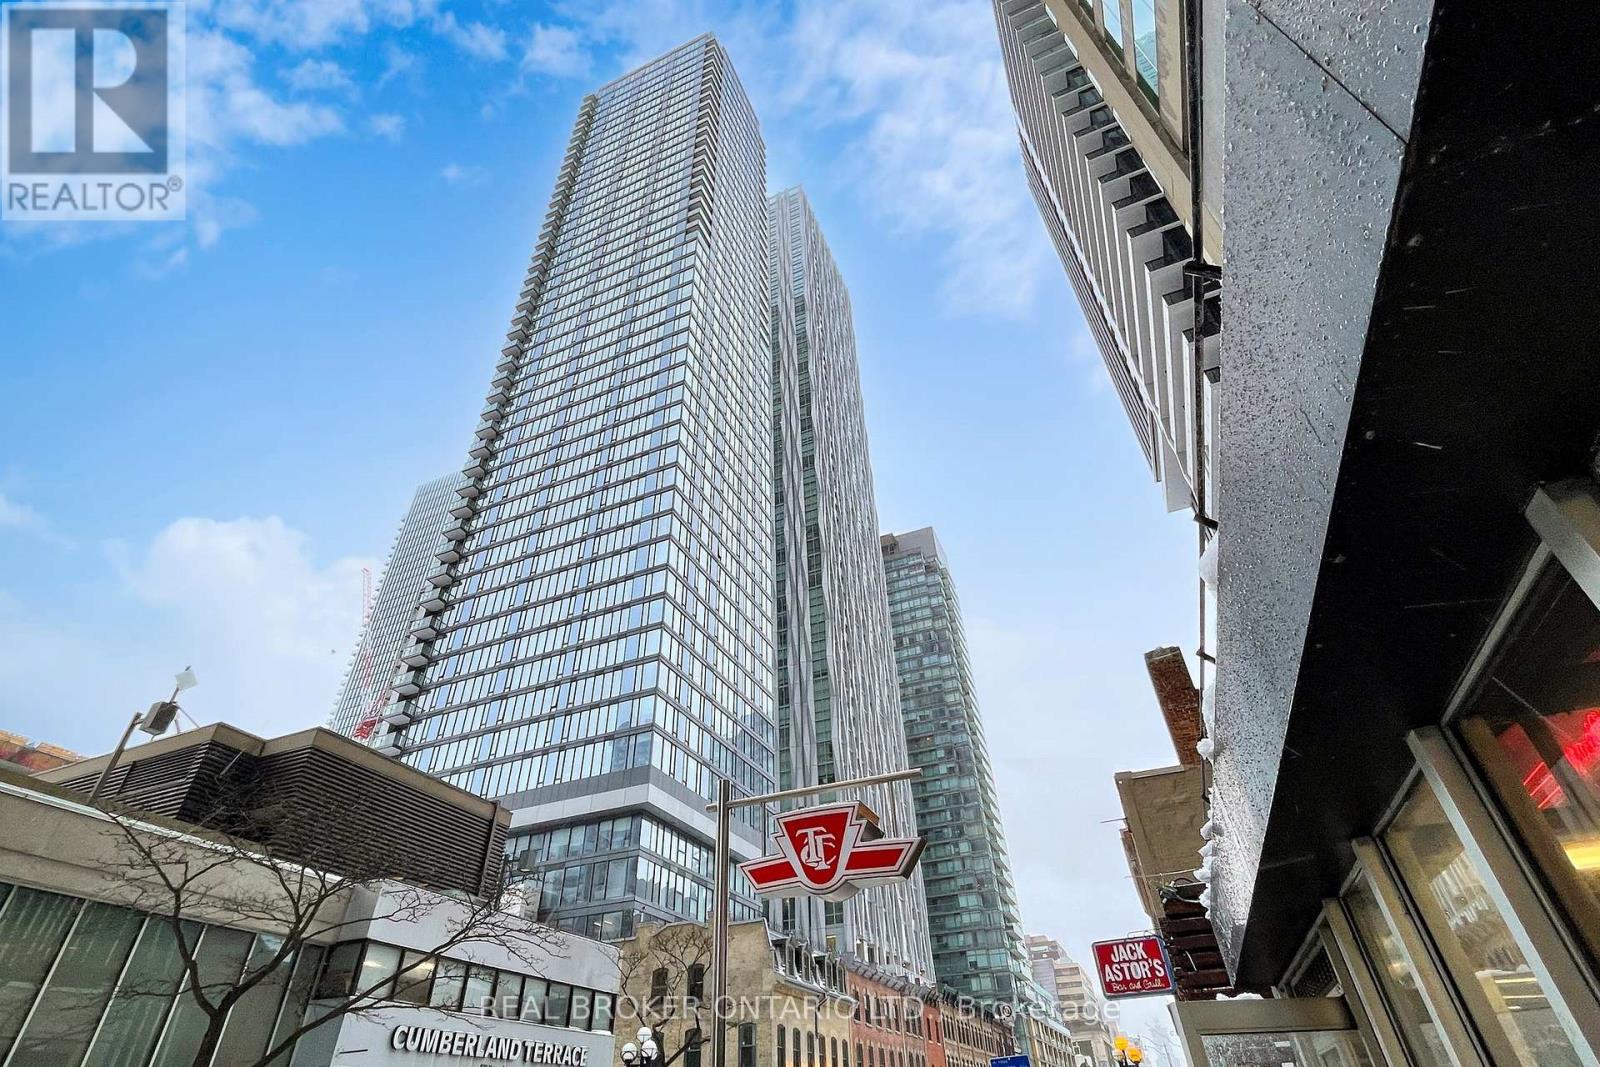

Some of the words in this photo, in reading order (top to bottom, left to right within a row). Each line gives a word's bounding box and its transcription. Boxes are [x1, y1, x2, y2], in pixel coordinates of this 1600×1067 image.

[1111, 942, 1148, 962] JACK
[1104, 958, 1165, 982] ASTOR'S
[392, 1025, 522, 1060] CUMBERLAND
[523, 1039, 589, 1067] TERRACE
